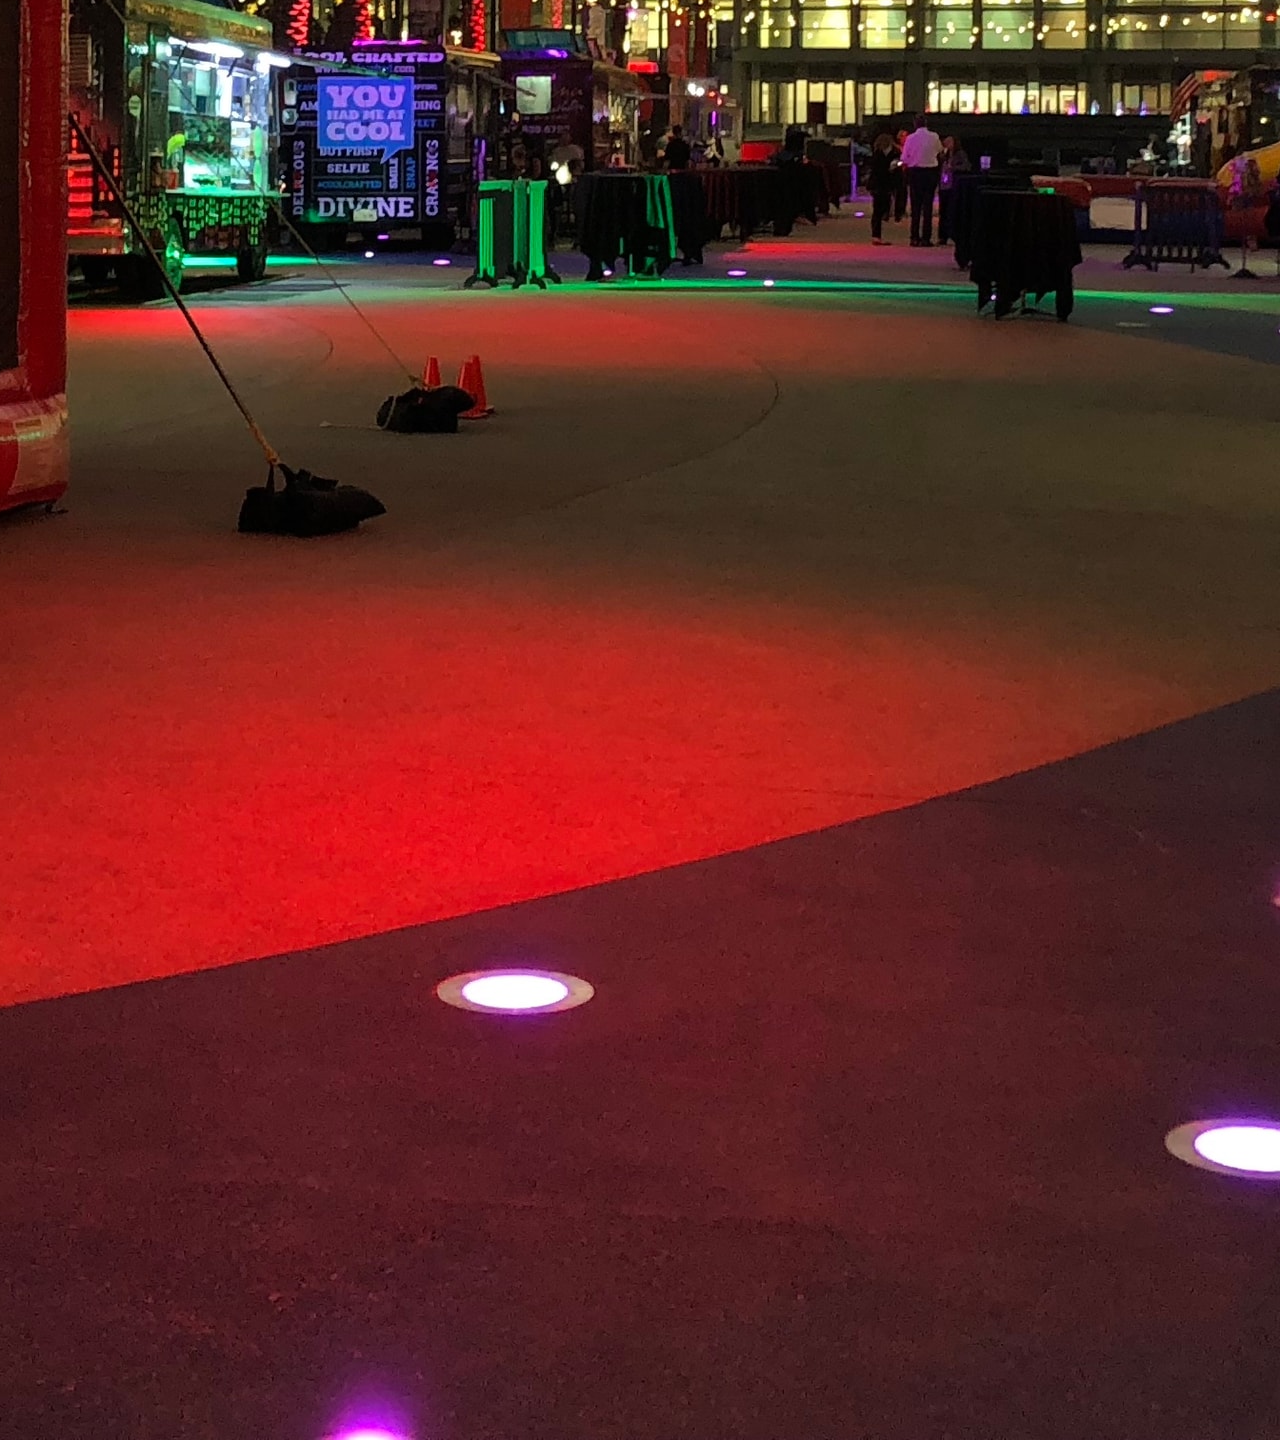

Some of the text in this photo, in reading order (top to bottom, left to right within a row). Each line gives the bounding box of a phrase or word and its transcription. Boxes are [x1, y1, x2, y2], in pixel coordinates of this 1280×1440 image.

[351, 51, 445, 64] CRAFTED
[326, 85, 406, 108] YOU
[326, 109, 406, 121] HAD ME AT
[326, 121, 405, 141] COOL
[319, 146, 343, 157] BUT
[327, 163, 371, 174] SELFIE
[388, 157, 399, 190] SMILE
[405, 156, 416, 190] SNAP
[317, 196, 415, 218] DIVINE
